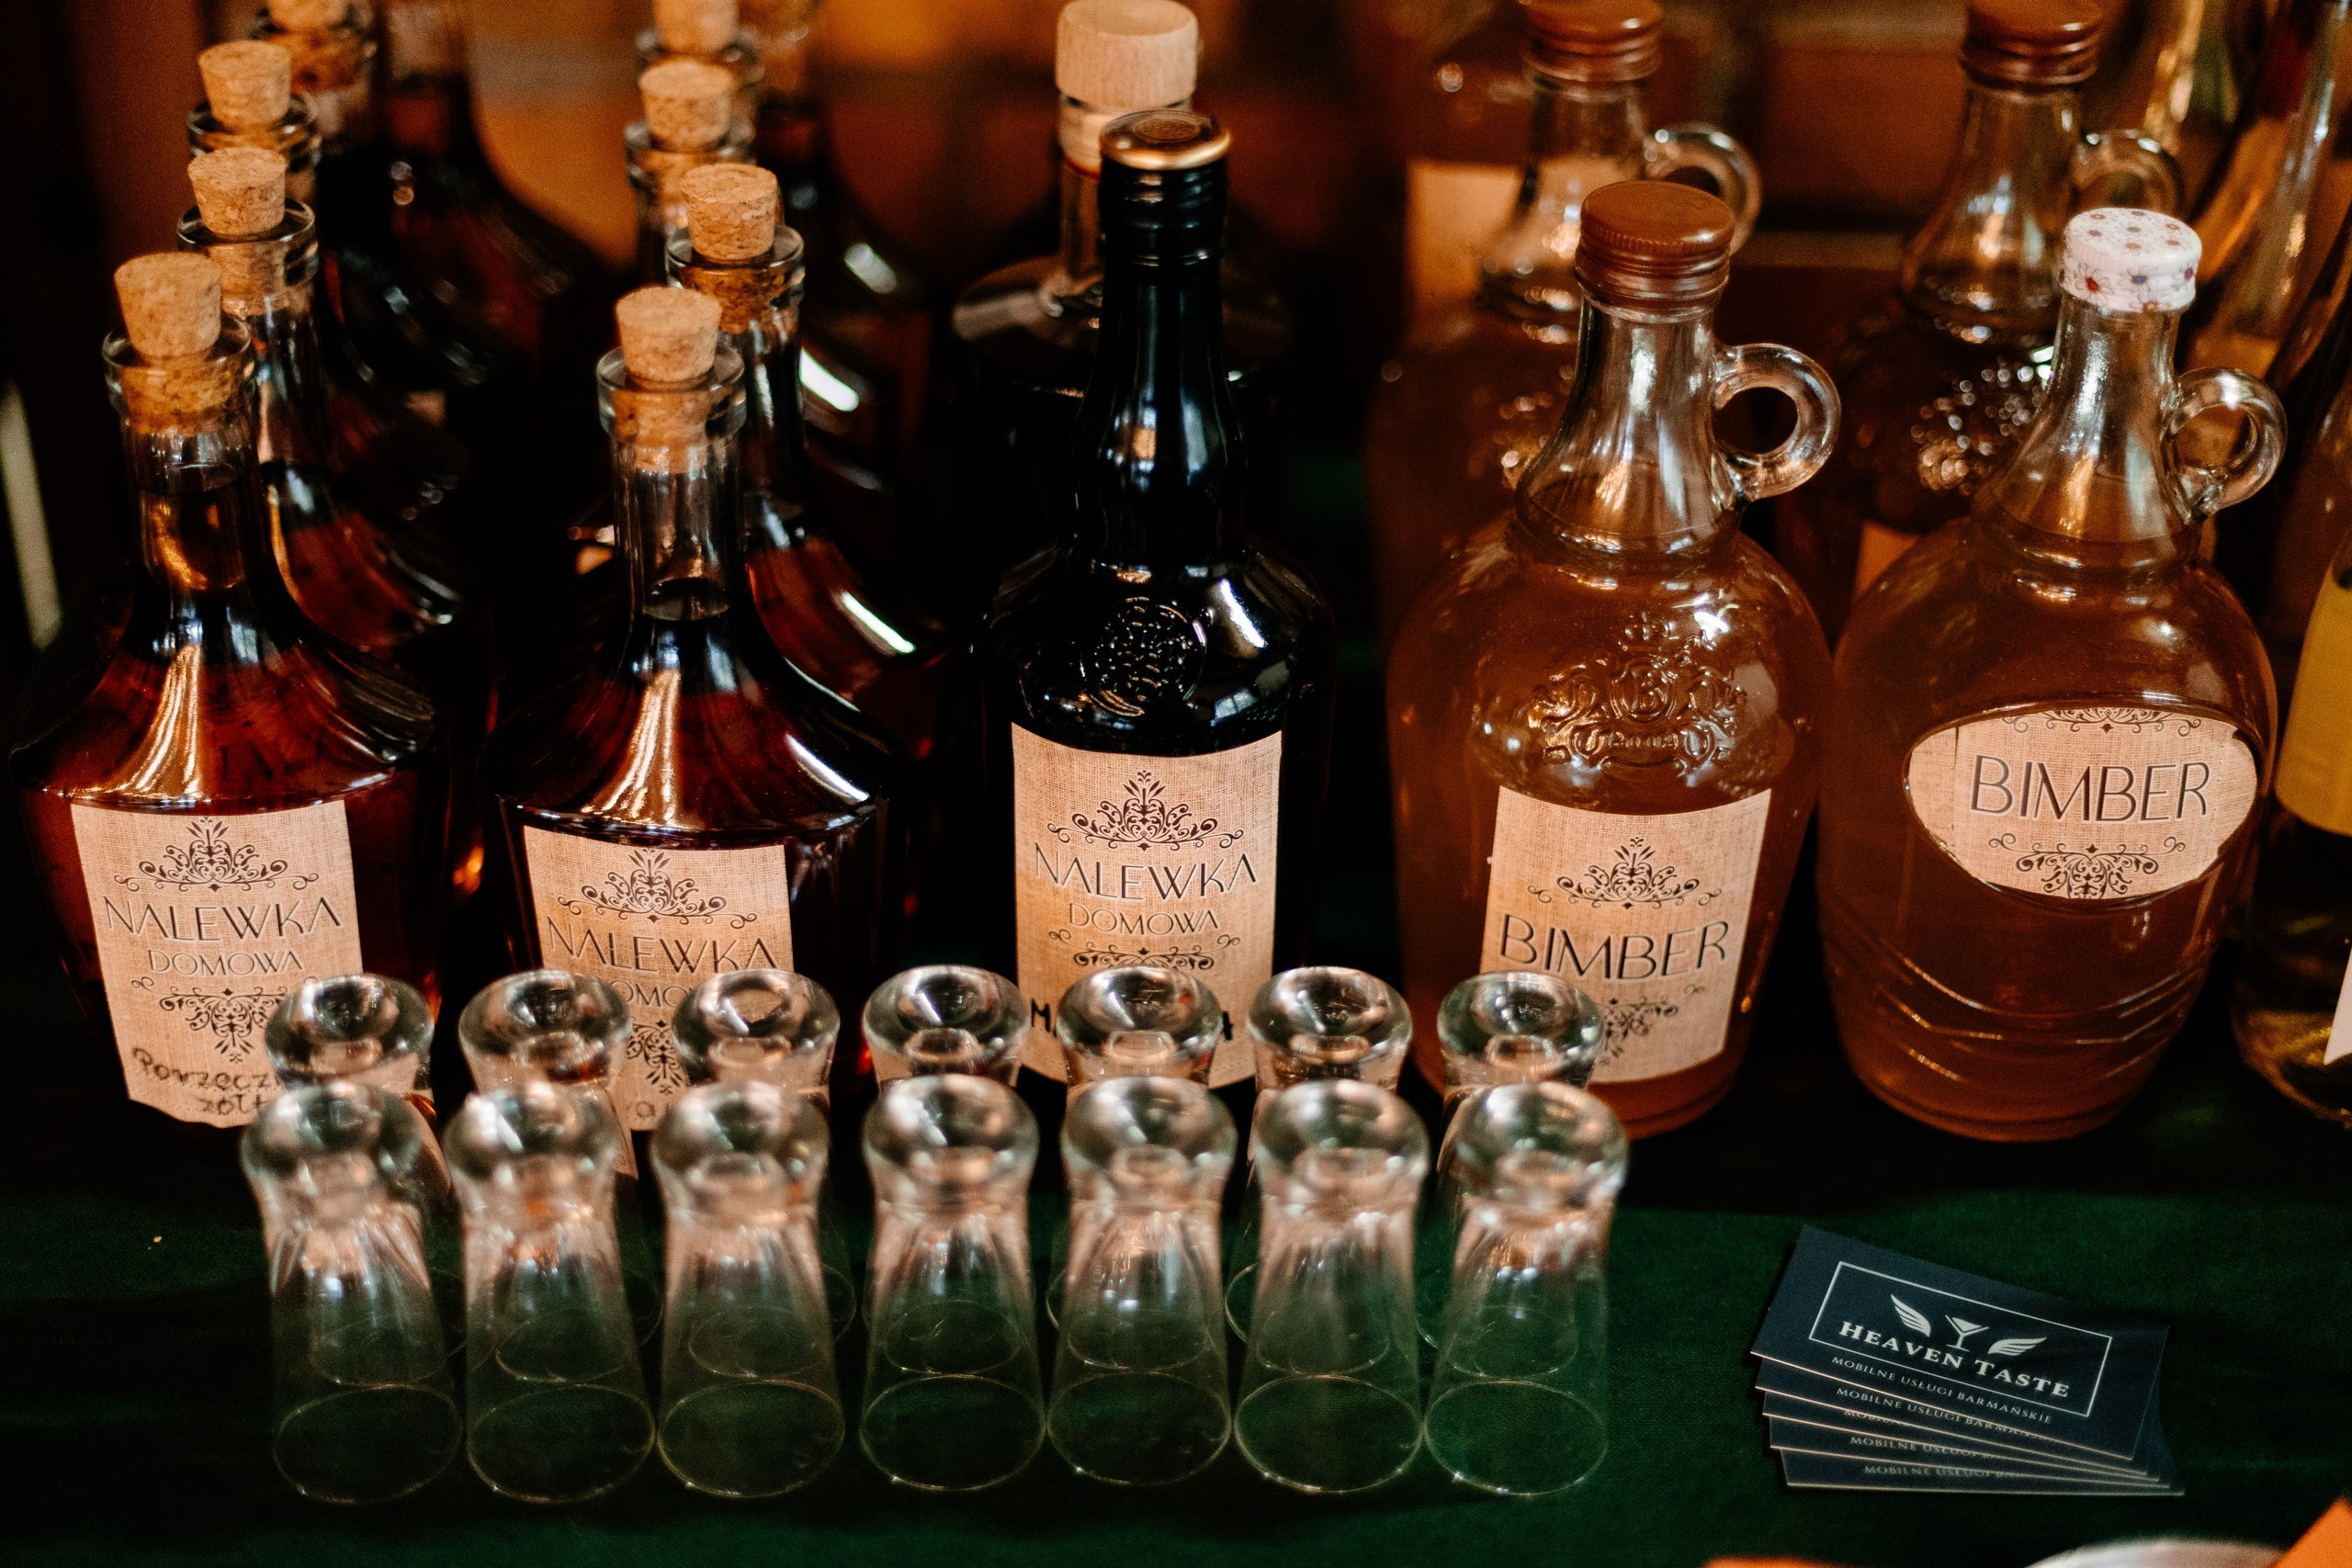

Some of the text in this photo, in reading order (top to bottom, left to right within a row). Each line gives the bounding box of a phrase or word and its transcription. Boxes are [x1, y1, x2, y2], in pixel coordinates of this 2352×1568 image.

[1970, 754, 2211, 822] BIMBER
[1035, 842, 1257, 900] NALEWKA
[103, 896, 343, 942] NALEWKA
[1069, 902, 1220, 935] DOMOWA
[148, 949, 304, 976] DOMOWA
[547, 916, 780, 974] NALEWKA
[1499, 913, 1729, 980] BIMBER
[1831, 1356, 1896, 1381] MOBILNE
[1838, 1321, 2070, 1397] HEAVEN TASTE
[1837, 1387, 1902, 1409] MOBILNE
[1850, 1437, 1917, 1451] MOBILNE
